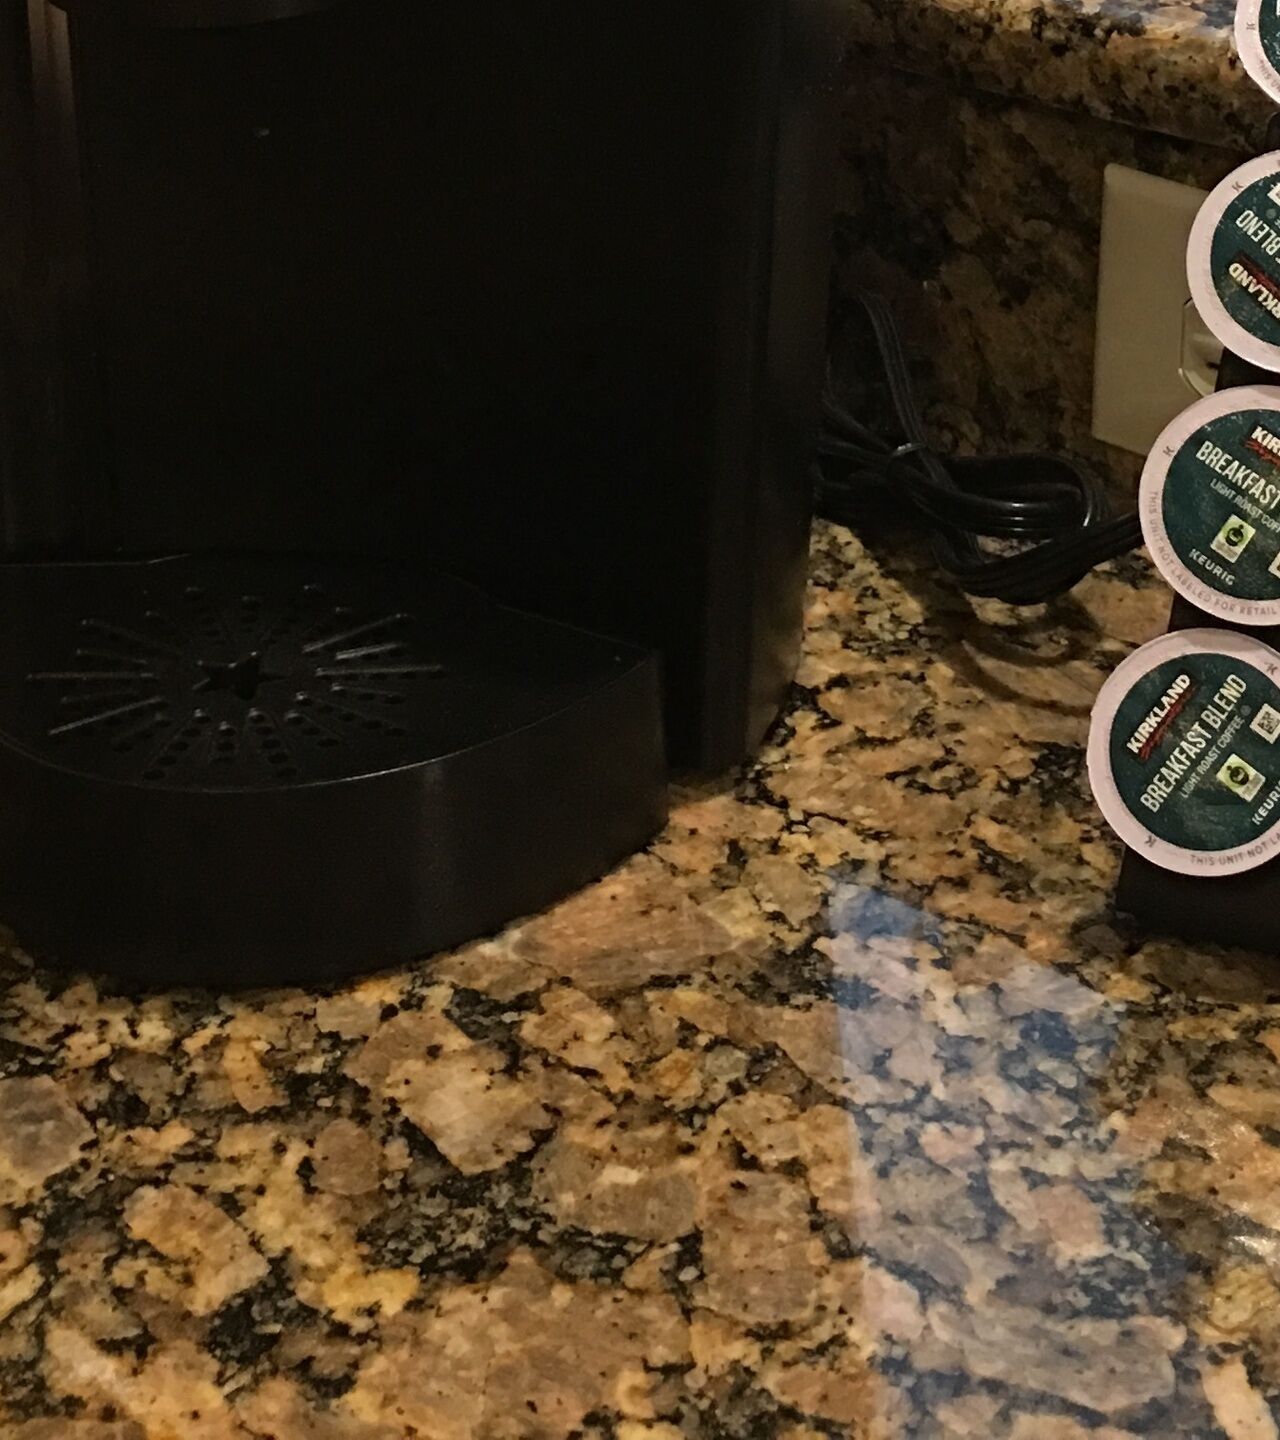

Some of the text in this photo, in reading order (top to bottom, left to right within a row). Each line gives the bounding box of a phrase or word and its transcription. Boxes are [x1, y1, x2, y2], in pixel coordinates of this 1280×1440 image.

[1189, 548, 1236, 585] KEURIG
[1127, 674, 1190, 753] KIRKLAND
[1140, 721, 1212, 813] BREAKFAST
[1201, 674, 1247, 731] BLEND
